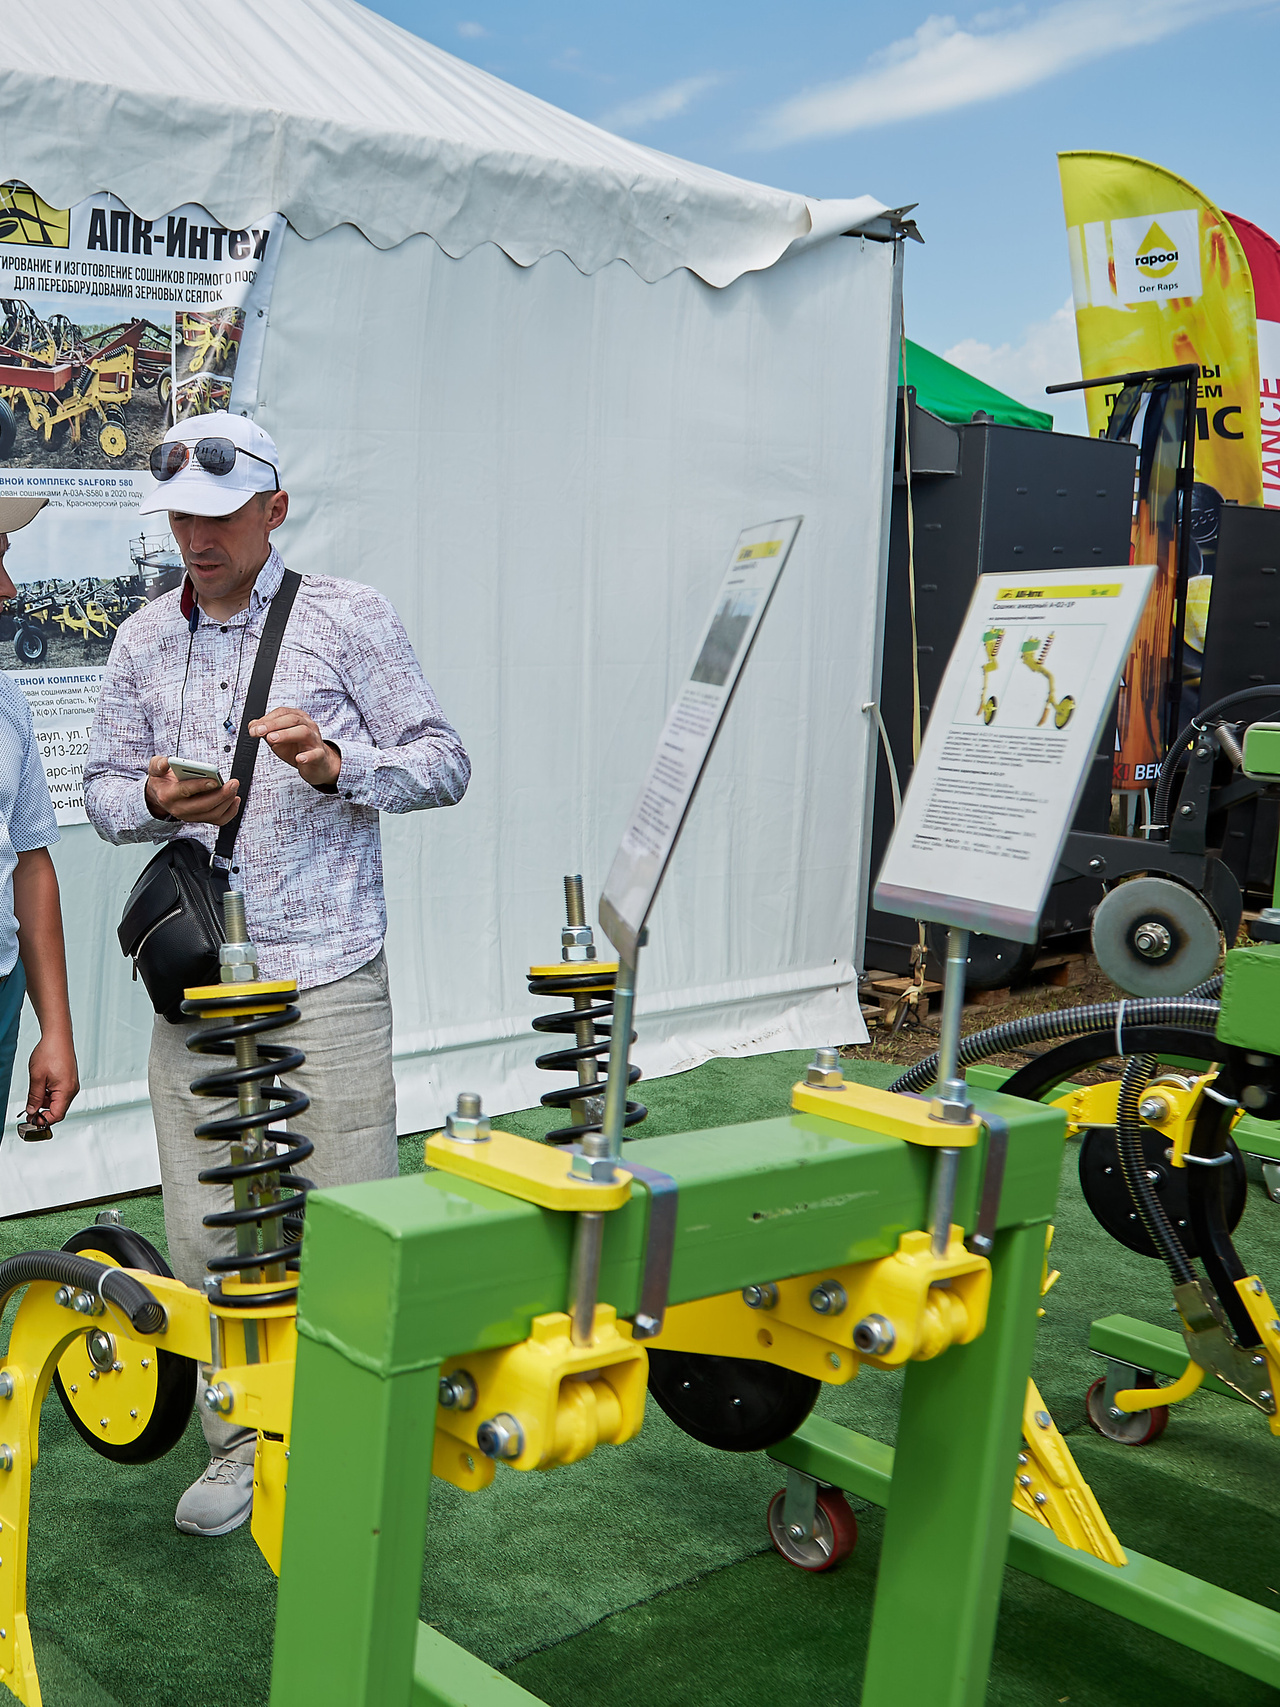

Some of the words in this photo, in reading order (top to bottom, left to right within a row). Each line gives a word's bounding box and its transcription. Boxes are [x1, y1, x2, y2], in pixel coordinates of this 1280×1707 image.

[1134, 250, 1180, 266] rapool
[54, 259, 62, 274] И
[64, 260, 133, 280] ИЗГОТОВЛЕНИЕ
[135, 267, 185, 284] СОШНИКОВ
[186, 271, 231, 286] ПРЯМОГО
[14, 275, 35, 291] ДЛЯ
[37, 277, 133, 299] ПЕРЕОБОРУДОВАНИЯ
[135, 285, 184, 302] ЗЕРНОВЫХ
[185, 289, 223, 304] СЕЯЛОК
[1138, 283, 1156, 294] Der
[1156, 281, 1180, 292] Raps
[27, 477, 76, 486] КОМПЛЕКС
[78, 478, 117, 487] SALFORD
[119, 479, 133, 487] 580
[19, 489, 61, 497] сошниками
[110, 489, 127, 498] 2020
[14, 676, 45, 686] ЕВНОЙ
[47, 674, 97, 685] КОМПЛЕКС
[40, 687, 82, 697] сошниками
[36, 708, 58, 719] К(Ф)Х
[65, 730, 84, 743] ул.
[39, 743, 89, 758] -913-222
